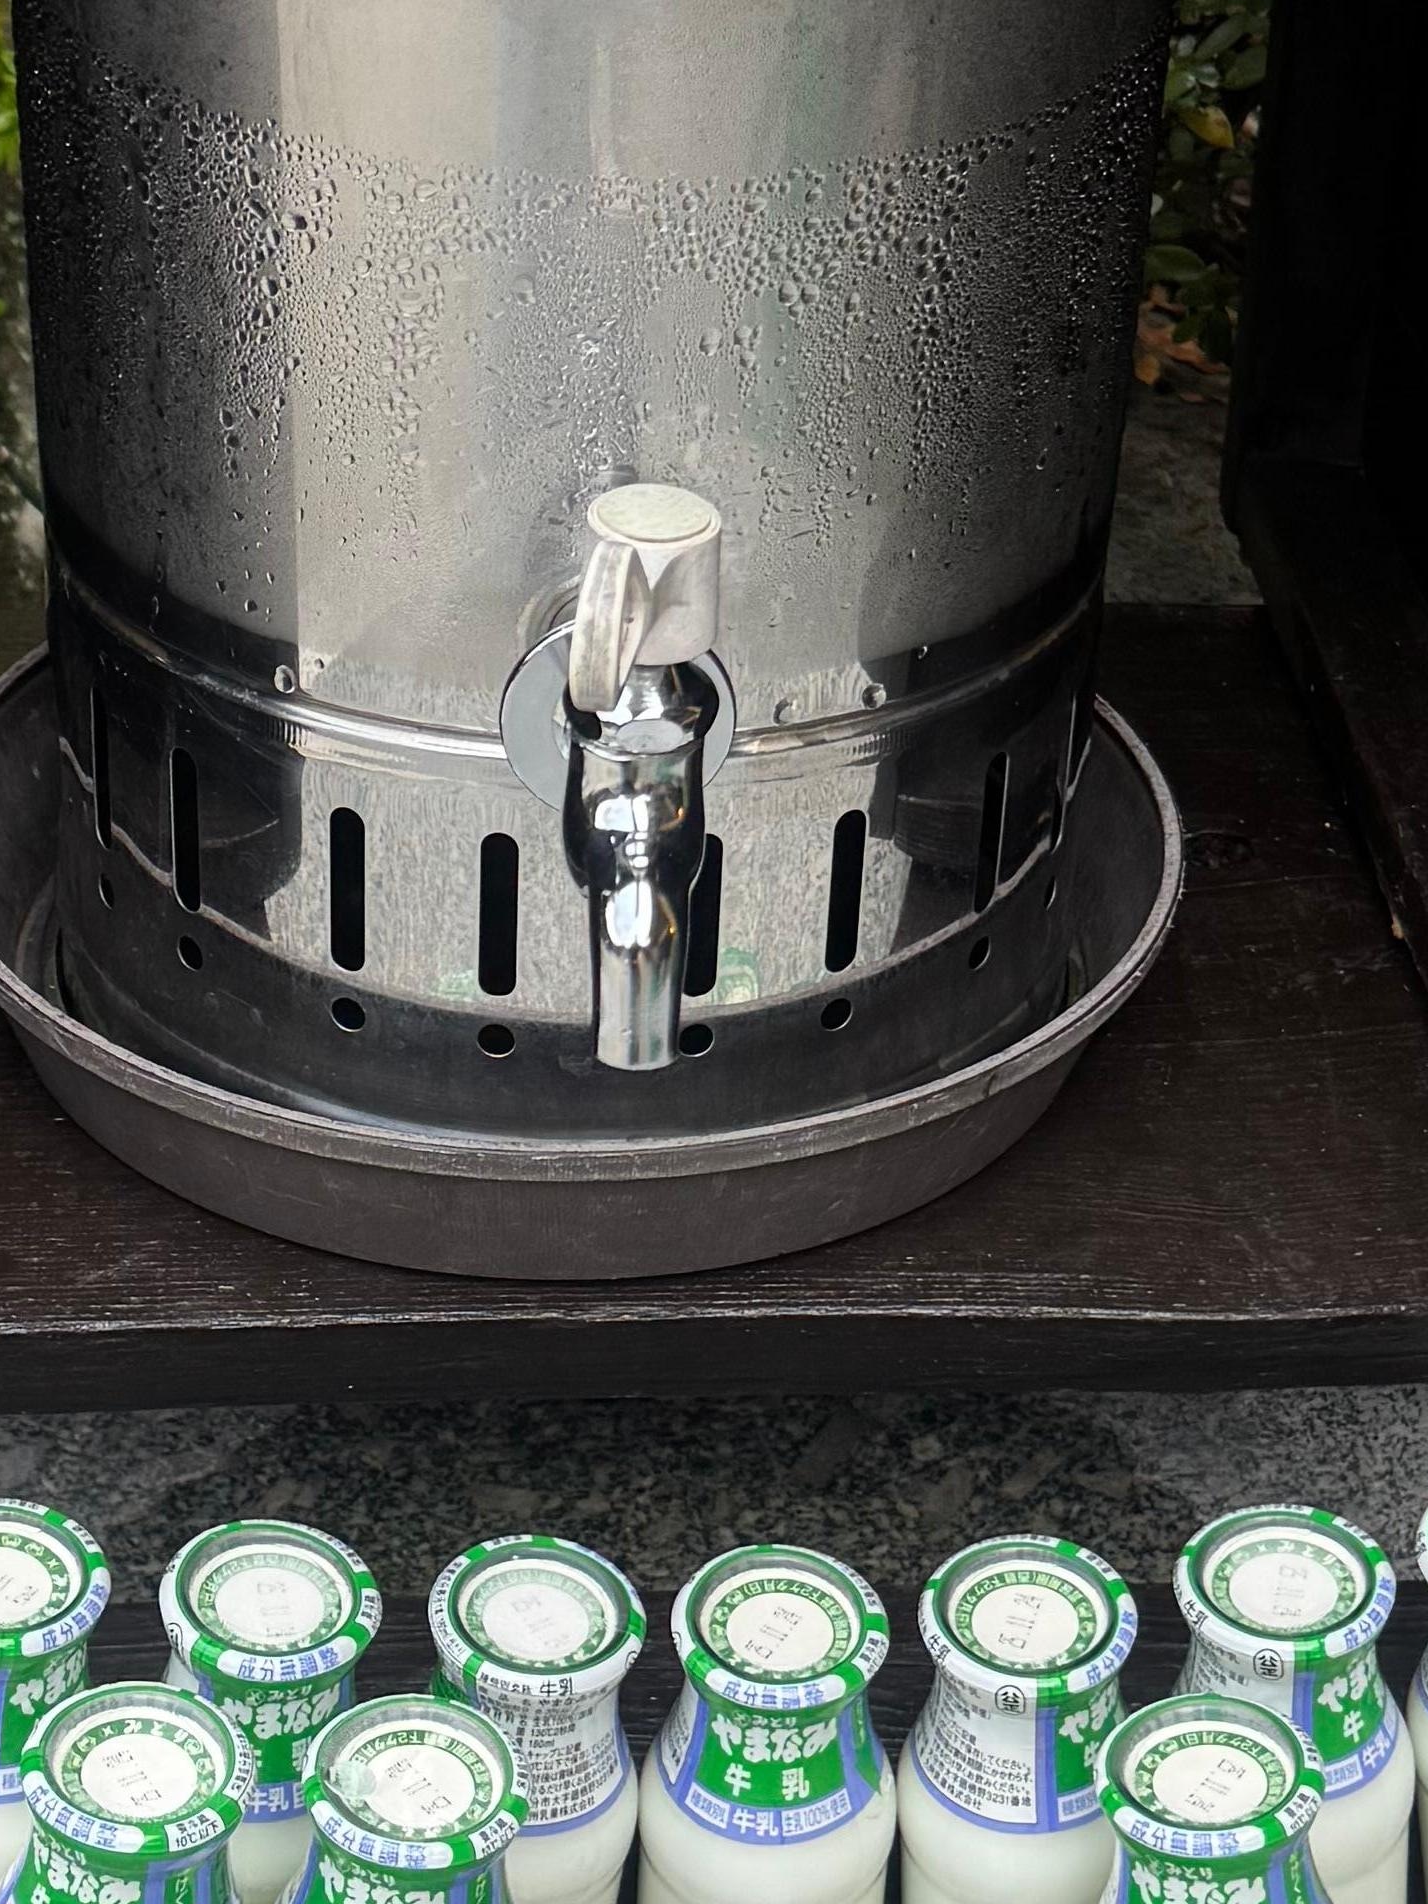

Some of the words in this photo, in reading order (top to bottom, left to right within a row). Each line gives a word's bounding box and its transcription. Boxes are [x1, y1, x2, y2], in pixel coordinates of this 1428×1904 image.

[722, 1680, 825, 1709] 成分無調整
[711, 1713, 838, 1763] やまなみ
[28, 1786, 118, 1849] 成分無調整
[731, 1807, 779, 1837] 牛乳
[1129, 1819, 1240, 1857] 成分無調整
[323, 1815, 427, 1869] 成分無調整
